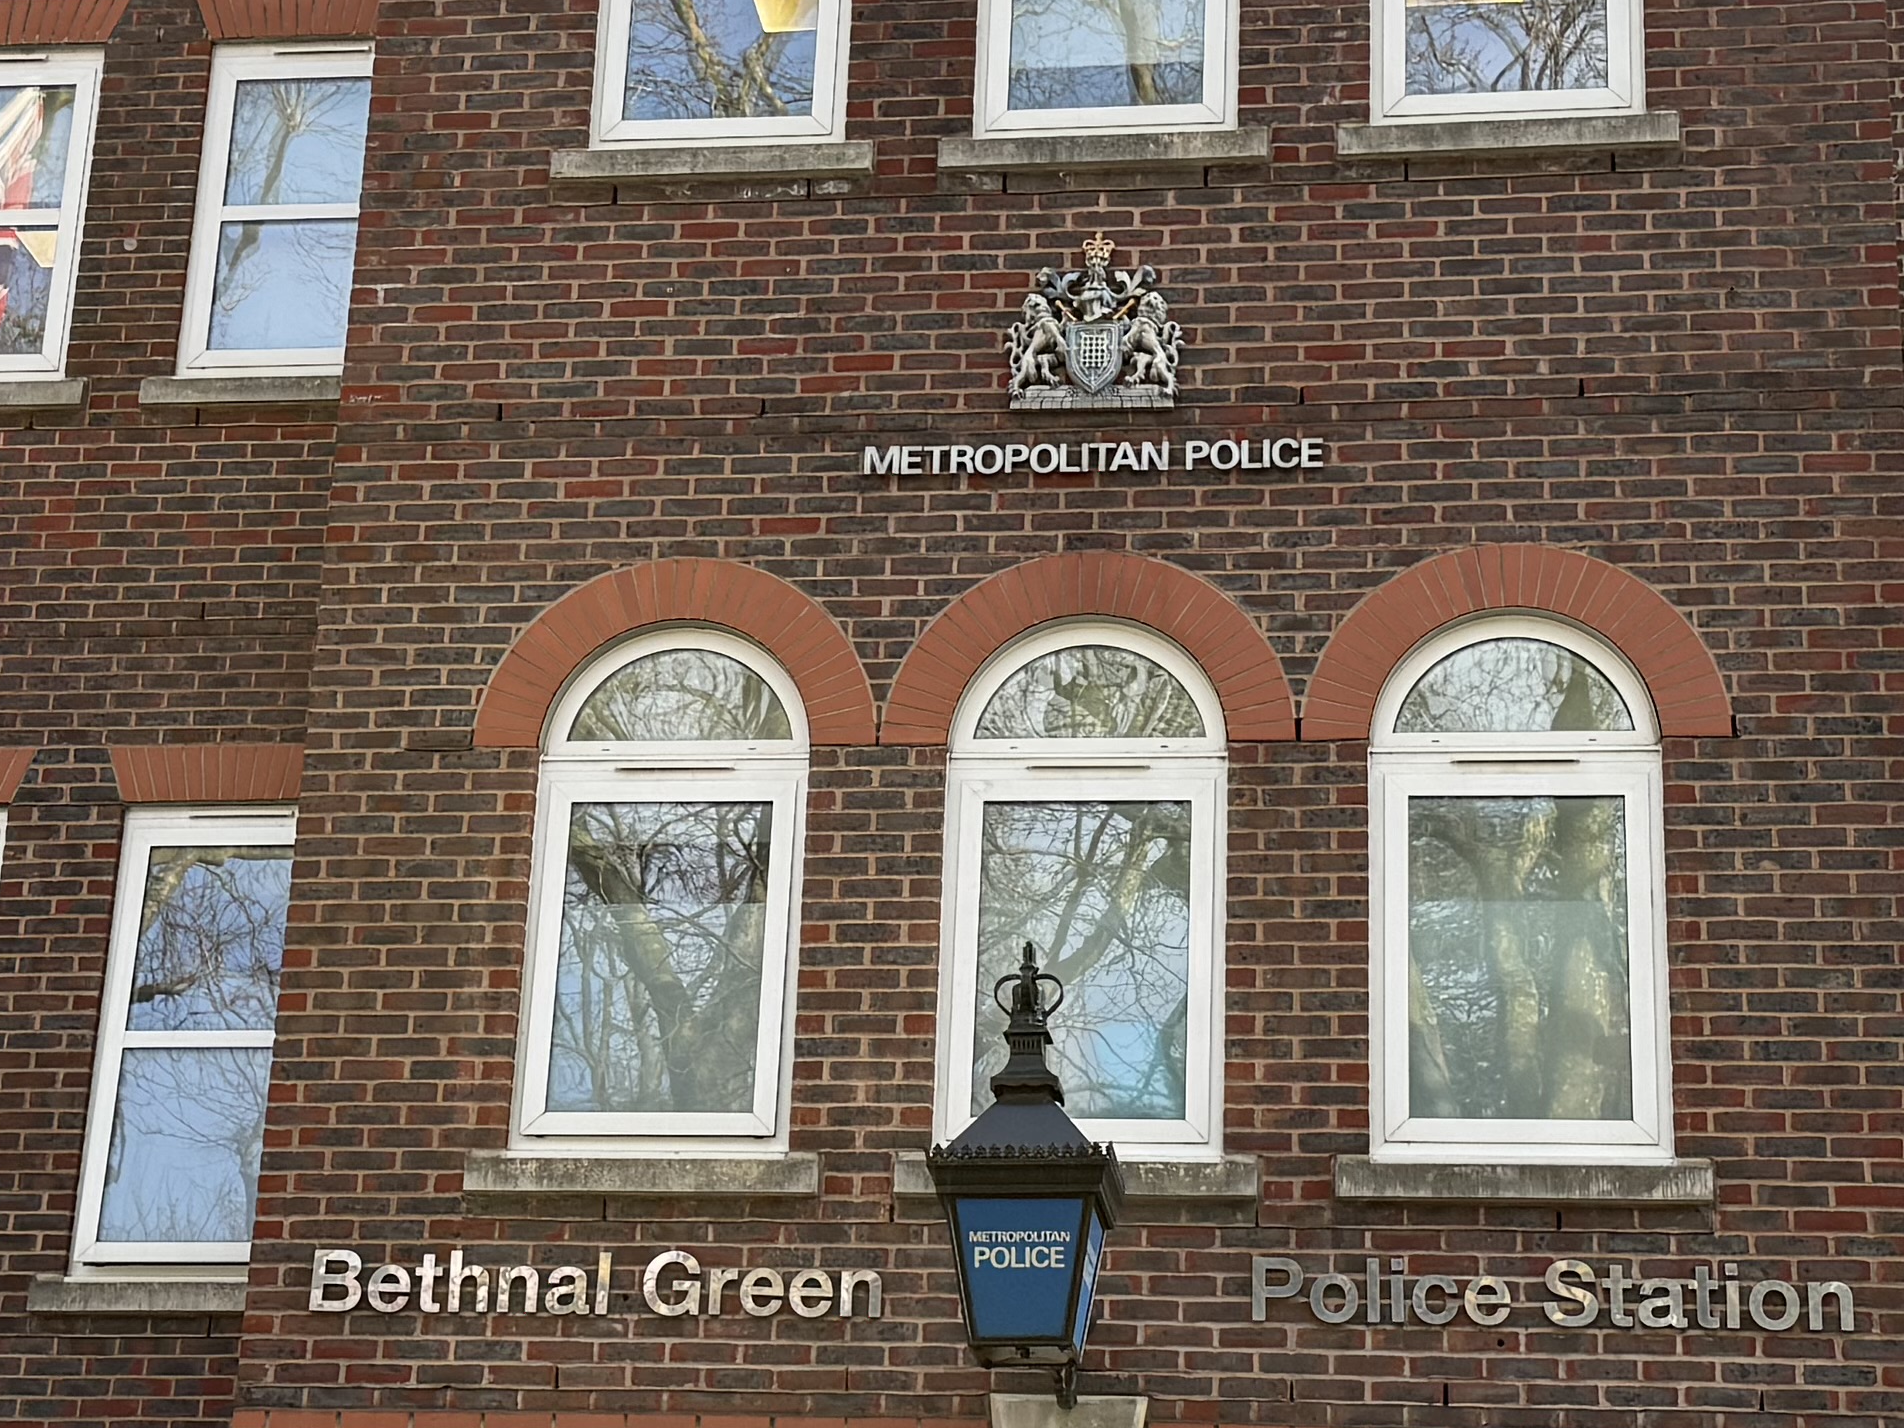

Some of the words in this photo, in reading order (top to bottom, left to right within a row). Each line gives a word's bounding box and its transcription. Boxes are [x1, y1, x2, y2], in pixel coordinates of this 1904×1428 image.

[863, 440, 1170, 475] METROPOLITAN
[1185, 438, 1324, 470] POLICE
[969, 1230, 1070, 1243] METROPOLITAN
[974, 1246, 1065, 1268] POLICE
[307, 1248, 612, 1316] Bethnal
[642, 1250, 883, 1319] Green
[1251, 1256, 1512, 1326] Police
[1543, 1259, 1854, 1332] Station
